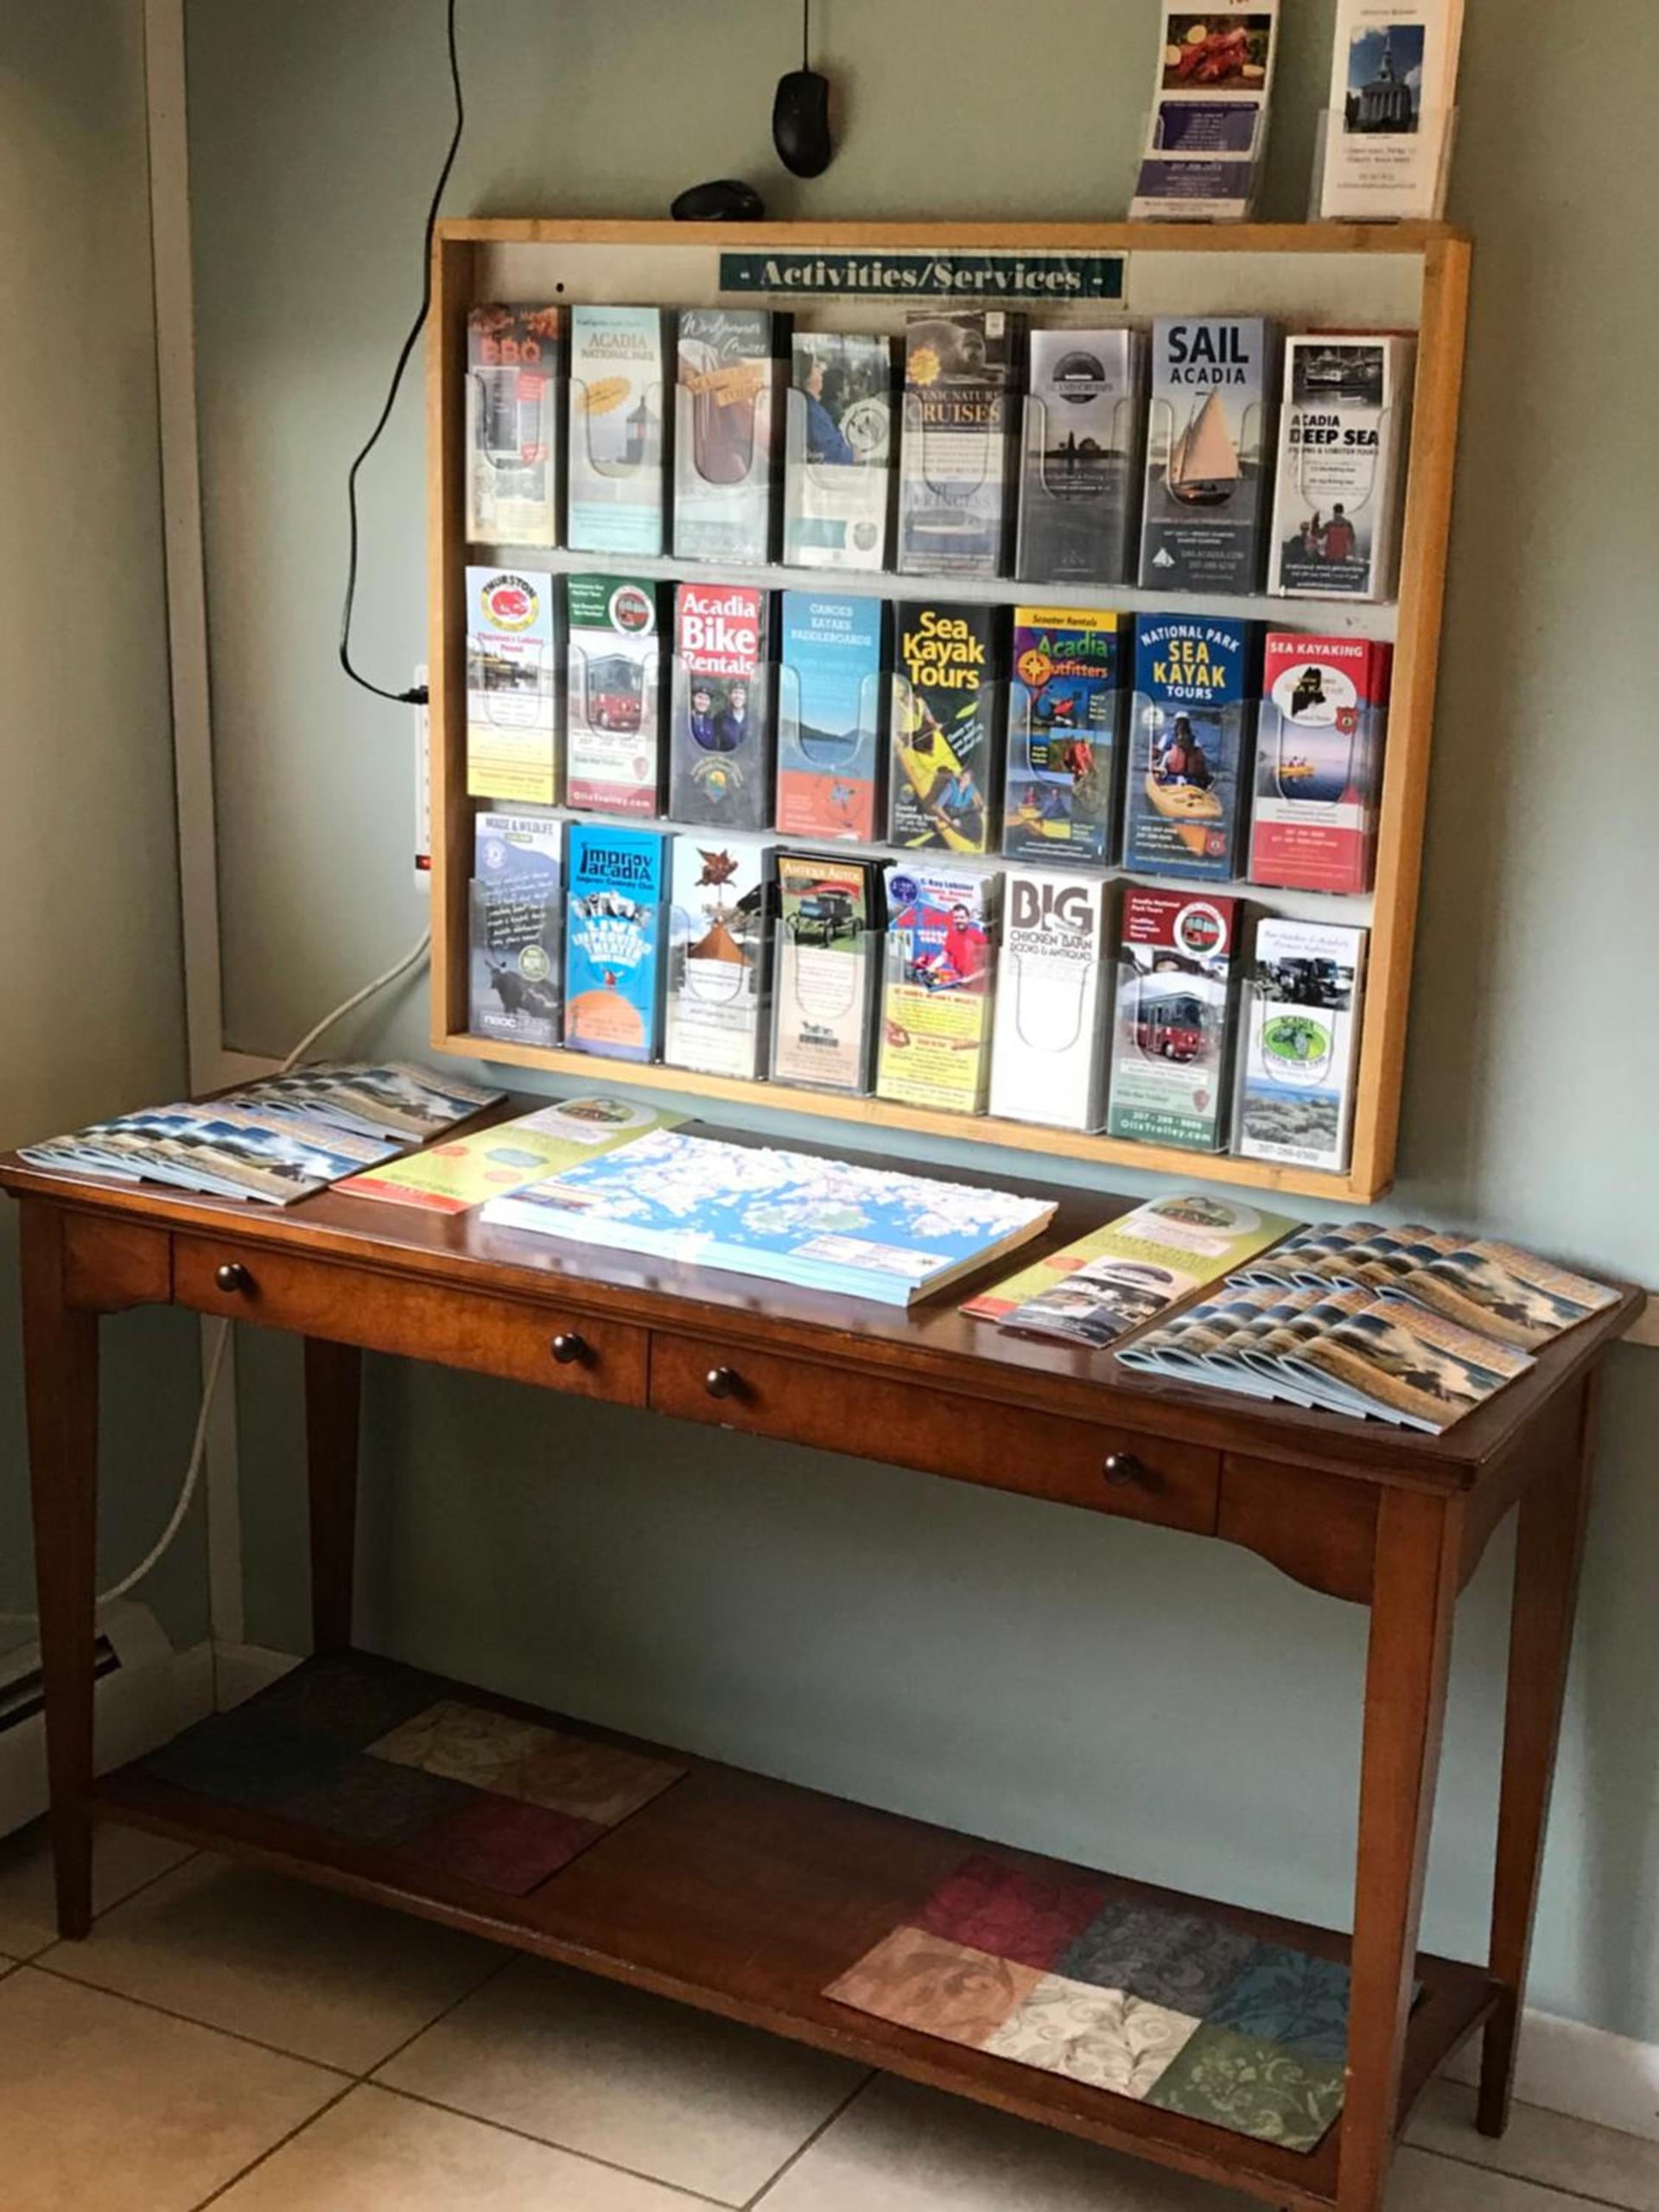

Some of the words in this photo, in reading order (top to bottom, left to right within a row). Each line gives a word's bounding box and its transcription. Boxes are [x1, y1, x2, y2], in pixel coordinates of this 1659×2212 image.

[760, 260, 1082, 290] Activities/Services
[480, 335, 541, 364] BBQ
[588, 332, 648, 349] ACADIA
[1168, 326, 1249, 364] SAIL
[581, 348, 627, 360] NATIONAL
[1170, 367, 1246, 385] ACADIA
[1290, 415, 1341, 427] ACADIA
[1288, 428, 1339, 445] DEEP
[1343, 429, 1379, 446] SEA
[683, 592, 756, 618] Acadia
[810, 603, 854, 618] CANOES
[811, 617, 853, 631] KAYAKS
[919, 611, 969, 640] Sea
[1033, 614, 1065, 626] Scooter
[1066, 616, 1097, 628] Rentals
[682, 615, 757, 655] Bike
[1037, 630, 1109, 658] Acadia
[1141, 626, 1204, 646] NATIONAL
[1206, 628, 1241, 653] PARK
[903, 632, 986, 668] Kayak
[1168, 640, 1210, 664] SEA
[1270, 642, 1294, 654] SEA
[1296, 644, 1363, 658] KAYAKING
[680, 651, 756, 676] Rentals
[906, 659, 981, 690] Tours
[1154, 662, 1226, 689] KAYAK
[1166, 685, 1213, 700] TOURS
[1011, 880, 1094, 936] BIG
[1009, 943, 1039, 955] BOOKS
[1010, 930, 1058, 945] CHICKEN
[1060, 933, 1092, 949] BARN
